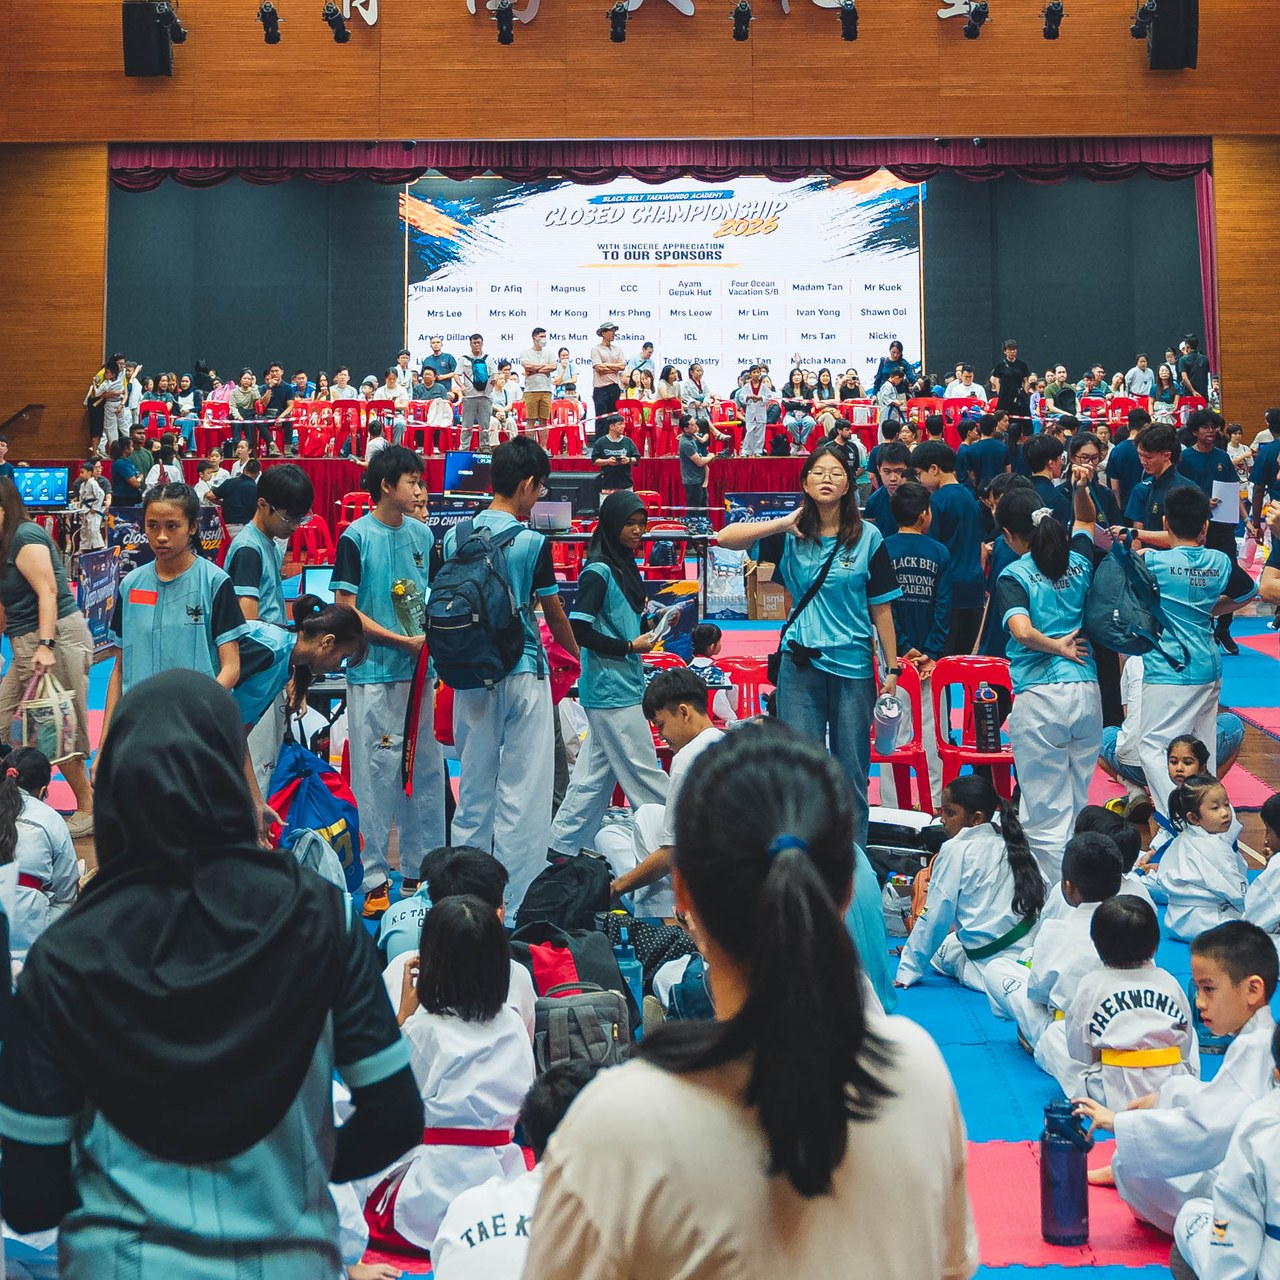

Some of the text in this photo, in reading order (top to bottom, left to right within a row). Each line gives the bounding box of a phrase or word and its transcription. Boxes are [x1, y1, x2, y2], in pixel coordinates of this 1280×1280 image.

[627, 195, 645, 203] BELT
[646, 193, 689, 202] TAEKWONDO
[691, 192, 724, 200] ACADEMY
[544, 200, 788, 227] CLOSED CHAMPIONSHIP
[712, 216, 779, 239] 2026
[602, 251, 722, 260] TO OUR SPONSORS
[620, 284, 638, 292] CCC
[678, 280, 702, 289] Ayam
[731, 280, 775, 288] Four Ocean
[792, 283, 843, 291] Madam Tan
[864, 283, 902, 292] Mr Kuek
[436, 285, 473, 294] Malaysia
[490, 285, 502, 293] Dr
[551, 285, 586, 294] Magnus
[669, 289, 694, 297] Gepuk
[728, 288, 779, 296] Vacation S/B
[427, 310, 462, 318] Mrs Lee
[508, 309, 527, 317] Koh
[550, 309, 588, 319] Mr Kong
[609, 309, 651, 319] Mrs Phng
[670, 309, 712, 317] Mrs Leow
[738, 308, 769, 317] Mr Lim
[796, 308, 841, 318] Ivan Yong
[861, 308, 890, 316] Shawn
[501, 333, 514, 341] KH
[549, 333, 588, 341] Mrs Mun
[615, 333, 645, 341] Sakina
[684, 333, 698, 341] ICL
[752, 332, 768, 340] Lim
[801, 332, 836, 340] Mrs Tan
[869, 332, 897, 340] Nickie
[694, 357, 720, 367] Pastry
[738, 357, 772, 365] Mrs Tan
[823, 356, 846, 365] Mana
[866, 356, 877, 364] Mr
[891, 556, 918, 570] LACK
[1170, 567, 1182, 576] K.C
[1190, 578, 1206, 587] CLUB
[391, 912, 406, 925] K.C
